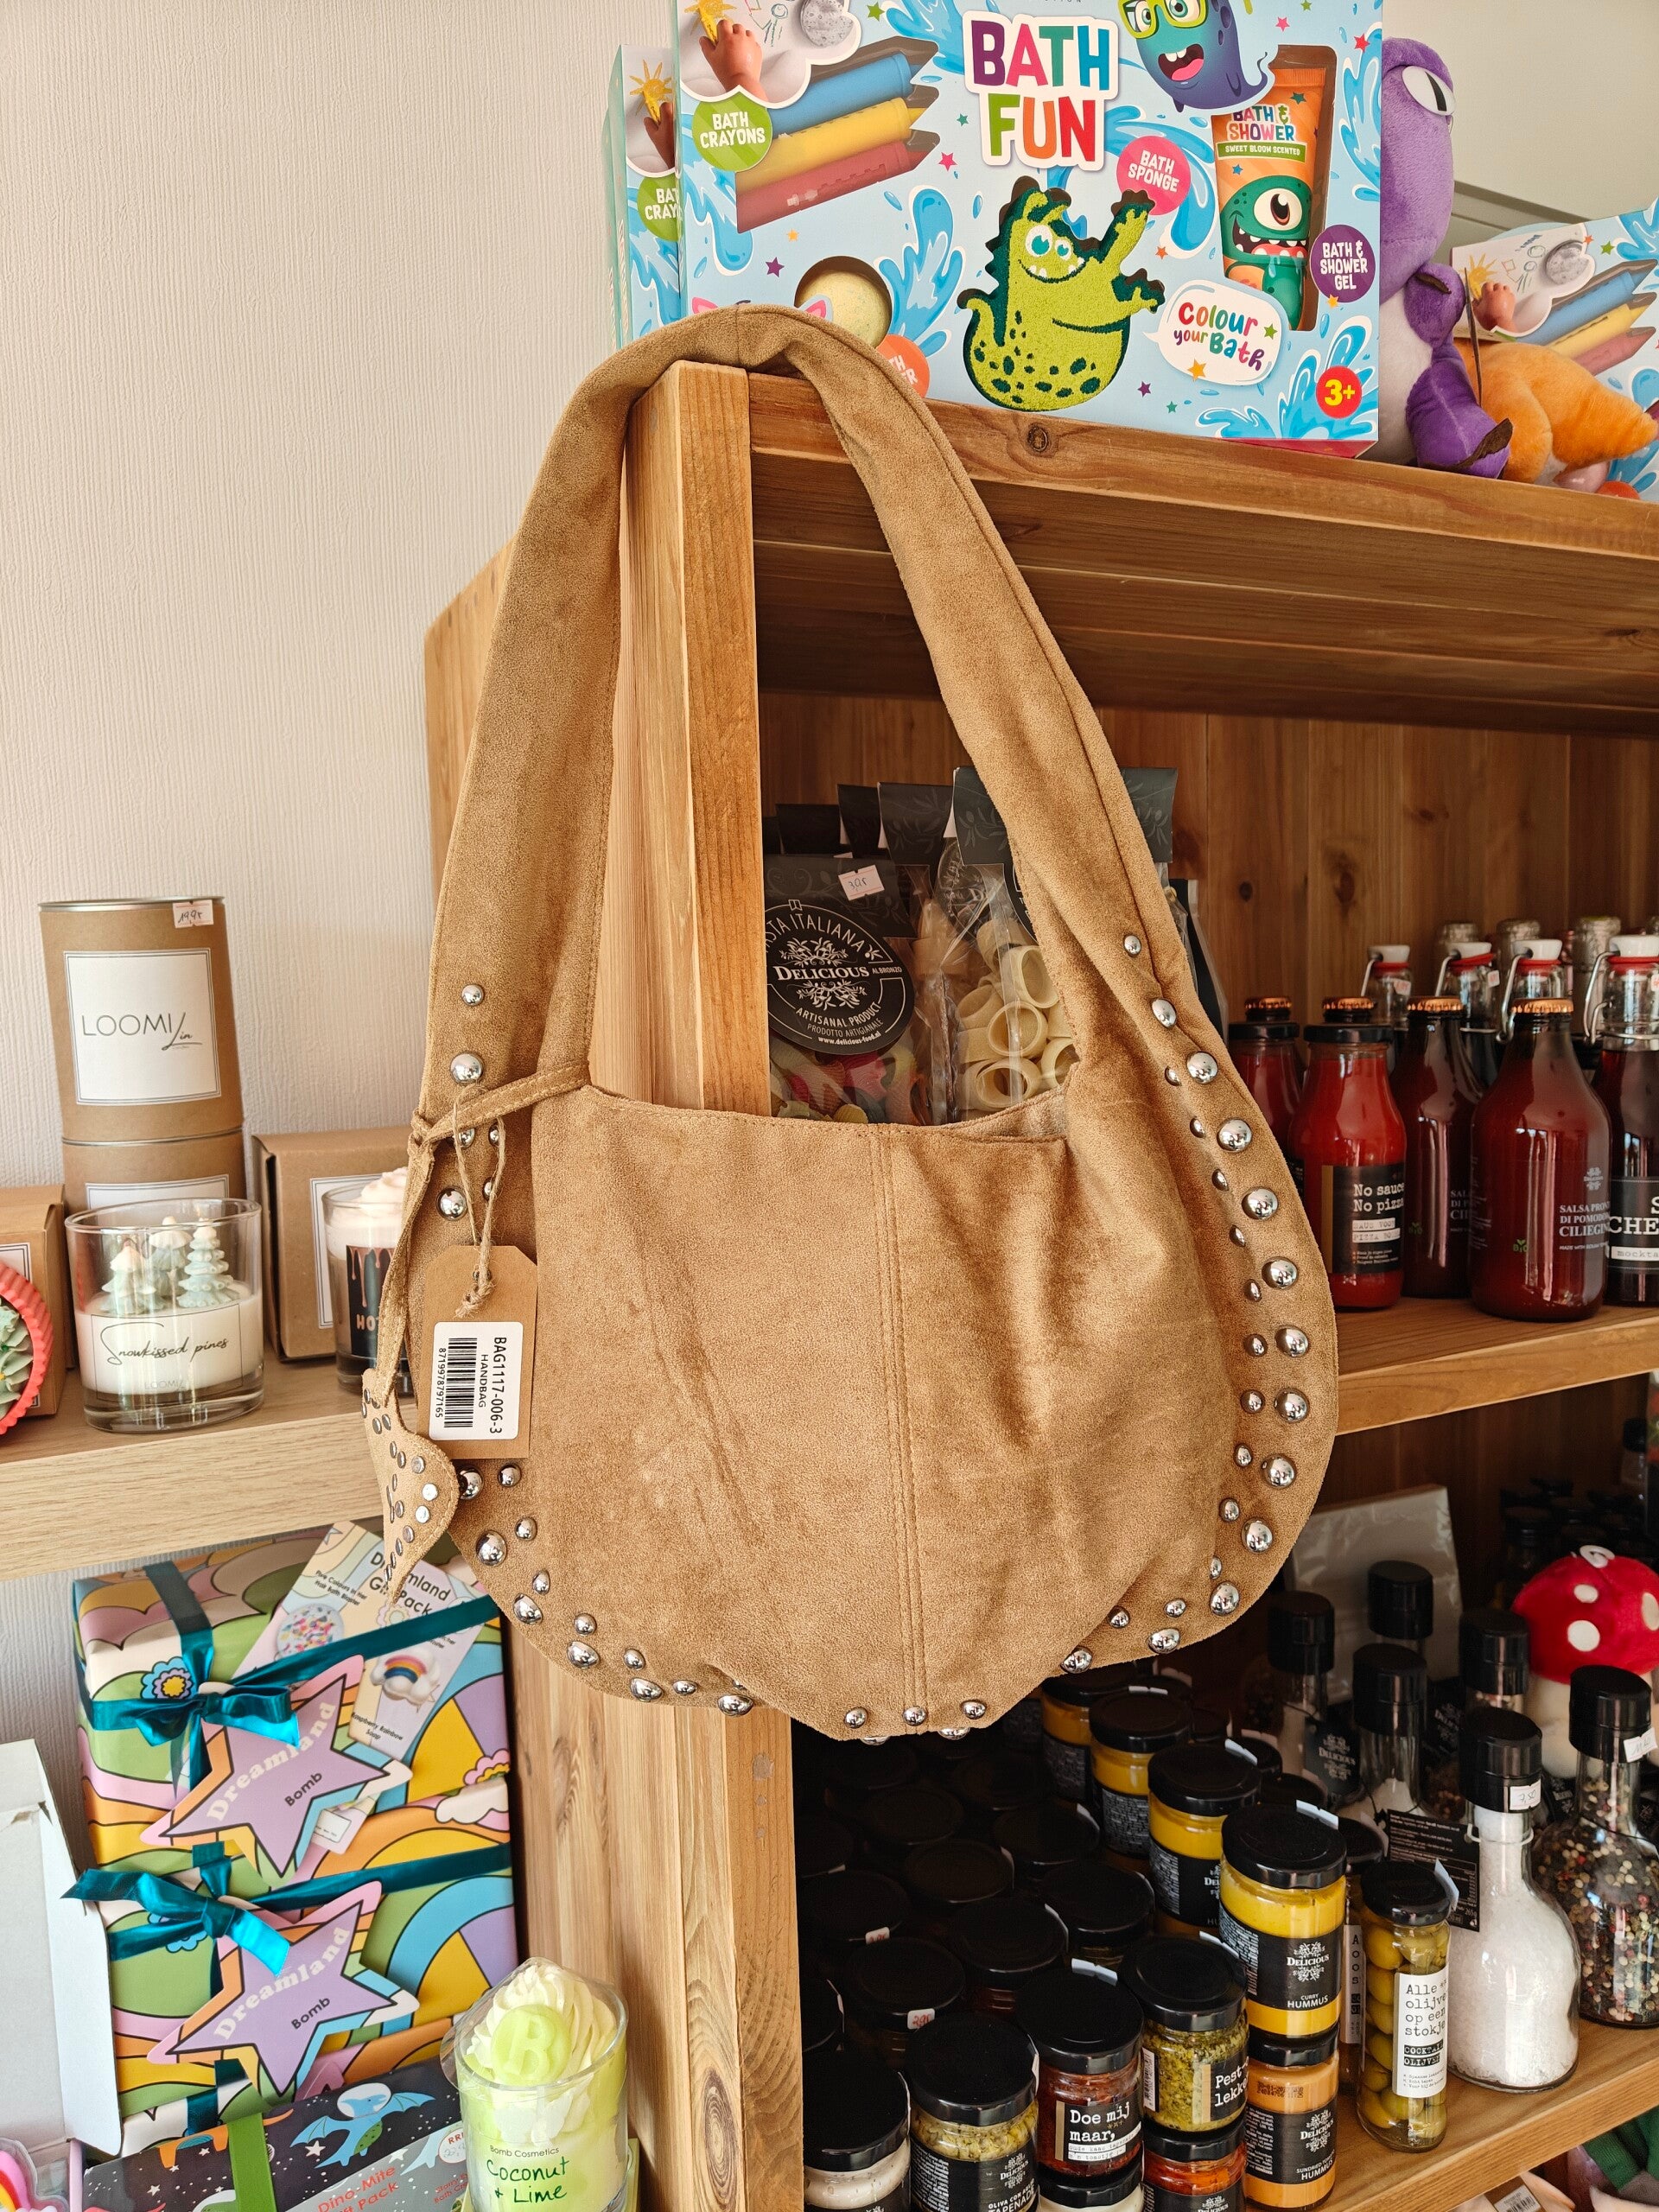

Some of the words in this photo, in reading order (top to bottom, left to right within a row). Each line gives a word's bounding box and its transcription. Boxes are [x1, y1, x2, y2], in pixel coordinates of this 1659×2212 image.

[971, 20, 1110, 91] BATH
[712, 111, 749, 130] BATH
[1232, 105, 1274, 123] BATH
[988, 92, 1096, 162] FUN
[1228, 124, 1295, 141] SHOWER
[699, 127, 766, 149] CRAYONS
[1225, 144, 1248, 153] SWEET
[1249, 144, 1272, 153] BLOOM
[1273, 146, 1300, 156] SCENTED
[1140, 149, 1175, 175] BATH
[1128, 163, 1180, 193] SPONGE
[1322, 242, 1352, 258] BATH
[1320, 258, 1368, 275] SHOWER
[1334, 273, 1357, 290] GEL
[1179, 302, 1258, 336] Colour
[1174, 327, 1209, 346] your
[1210, 332, 1265, 371] Bath
[1324, 379, 1356, 406] 3+
[790, 913, 865, 951] ITALIANA
[772, 965, 870, 981] DELICIOUS
[82, 1013, 173, 1036] LOOMI
[796, 1007, 846, 1027] ARTISANAL
[848, 1001, 881, 1026] PRODUCT
[807, 1023, 843, 1037] PRODOTTO
[845, 1017, 884, 1037] ARTIGIANALE
[817, 1031, 882, 1045] www.delicious-food.nl
[1353, 1184, 1373, 1197] No
[1353, 1198, 1372, 1211] No
[1559, 1204, 1589, 1213] SALSA
[1560, 1215, 1572, 1224] DI
[356, 1314, 378, 1332] HO
[100, 1321, 189, 1365] Snowkissed
[189, 1338, 230, 1363] pines
[435, 1347, 447, 1419] 8719978797165
[478, 1354, 489, 1408] HANDBAG
[489, 1337, 507, 1434] BAG1117-006-3
[206, 1702, 336, 1821] Dreamland
[284, 1771, 323, 1807] Bomb
[1287, 1955, 1330, 1966] DELICIOUS
[213, 1927, 351, 2040] Dreamland
[1406, 1984, 1438, 1995] Alle
[1287, 1995, 1329, 2008] HUMMUS
[290, 1997, 331, 2030] Bomb
[1405, 2014, 1423, 2025] op
[1427, 2007, 1446, 2022] een
[1405, 2020, 1446, 2037] stokje
[1070, 2109, 1102, 2125] Doe
[1106, 2101, 1130, 2123] mij
[1069, 2130, 1116, 2141] maar,
[1300, 2118, 1333, 2140] DELICIOUS
[490, 2145, 512, 2157] Bomb
[514, 2147, 560, 2158] Cosmetics
[486, 2156, 569, 2182] Coconut
[1000, 2160, 1029, 2181] DELICIOUS
[1301, 2160, 1333, 2181] HUMMUS
[317, 2166, 397, 2212] Dino-Mite
[357, 2182, 400, 2209] Pack
[513, 2185, 568, 2203] Lime
[991, 2183, 1036, 2212] TAPENADE
[988, 2199, 1008, 2209] OLIVA
[1009, 2193, 1021, 2202] CON
